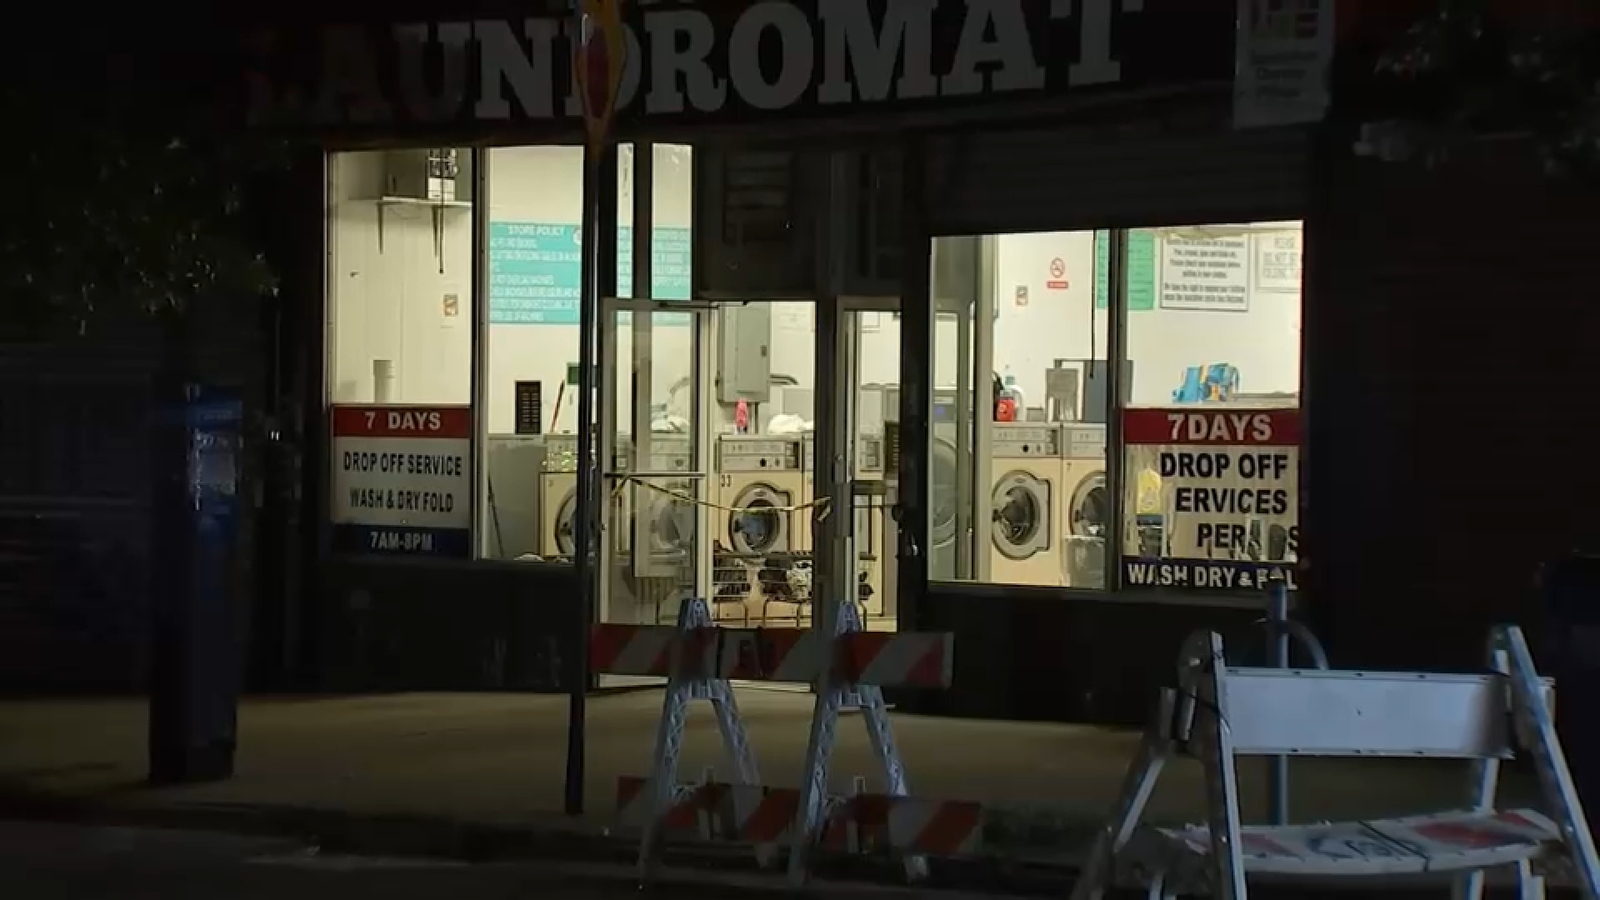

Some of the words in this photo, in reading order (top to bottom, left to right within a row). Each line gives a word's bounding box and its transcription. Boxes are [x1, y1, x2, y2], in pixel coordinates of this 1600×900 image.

[365, 411, 376, 428] 7
[388, 412, 441, 430] DAYS
[1167, 413, 1273, 441] 7DAYS
[344, 452, 377, 472] DROP
[381, 452, 404, 473] OFF
[408, 454, 462, 476] SERVICE
[1160, 452, 1230, 478] DROP
[1238, 454, 1288, 480] OFF
[350, 488, 384, 508] WASH
[387, 490, 394, 509] &
[397, 490, 421, 511] DRY
[423, 492, 454, 513] FOLD
[1127, 562, 1188, 586] WASH
[1194, 566, 1236, 588] DRY
[1238, 572, 1253, 586] &
